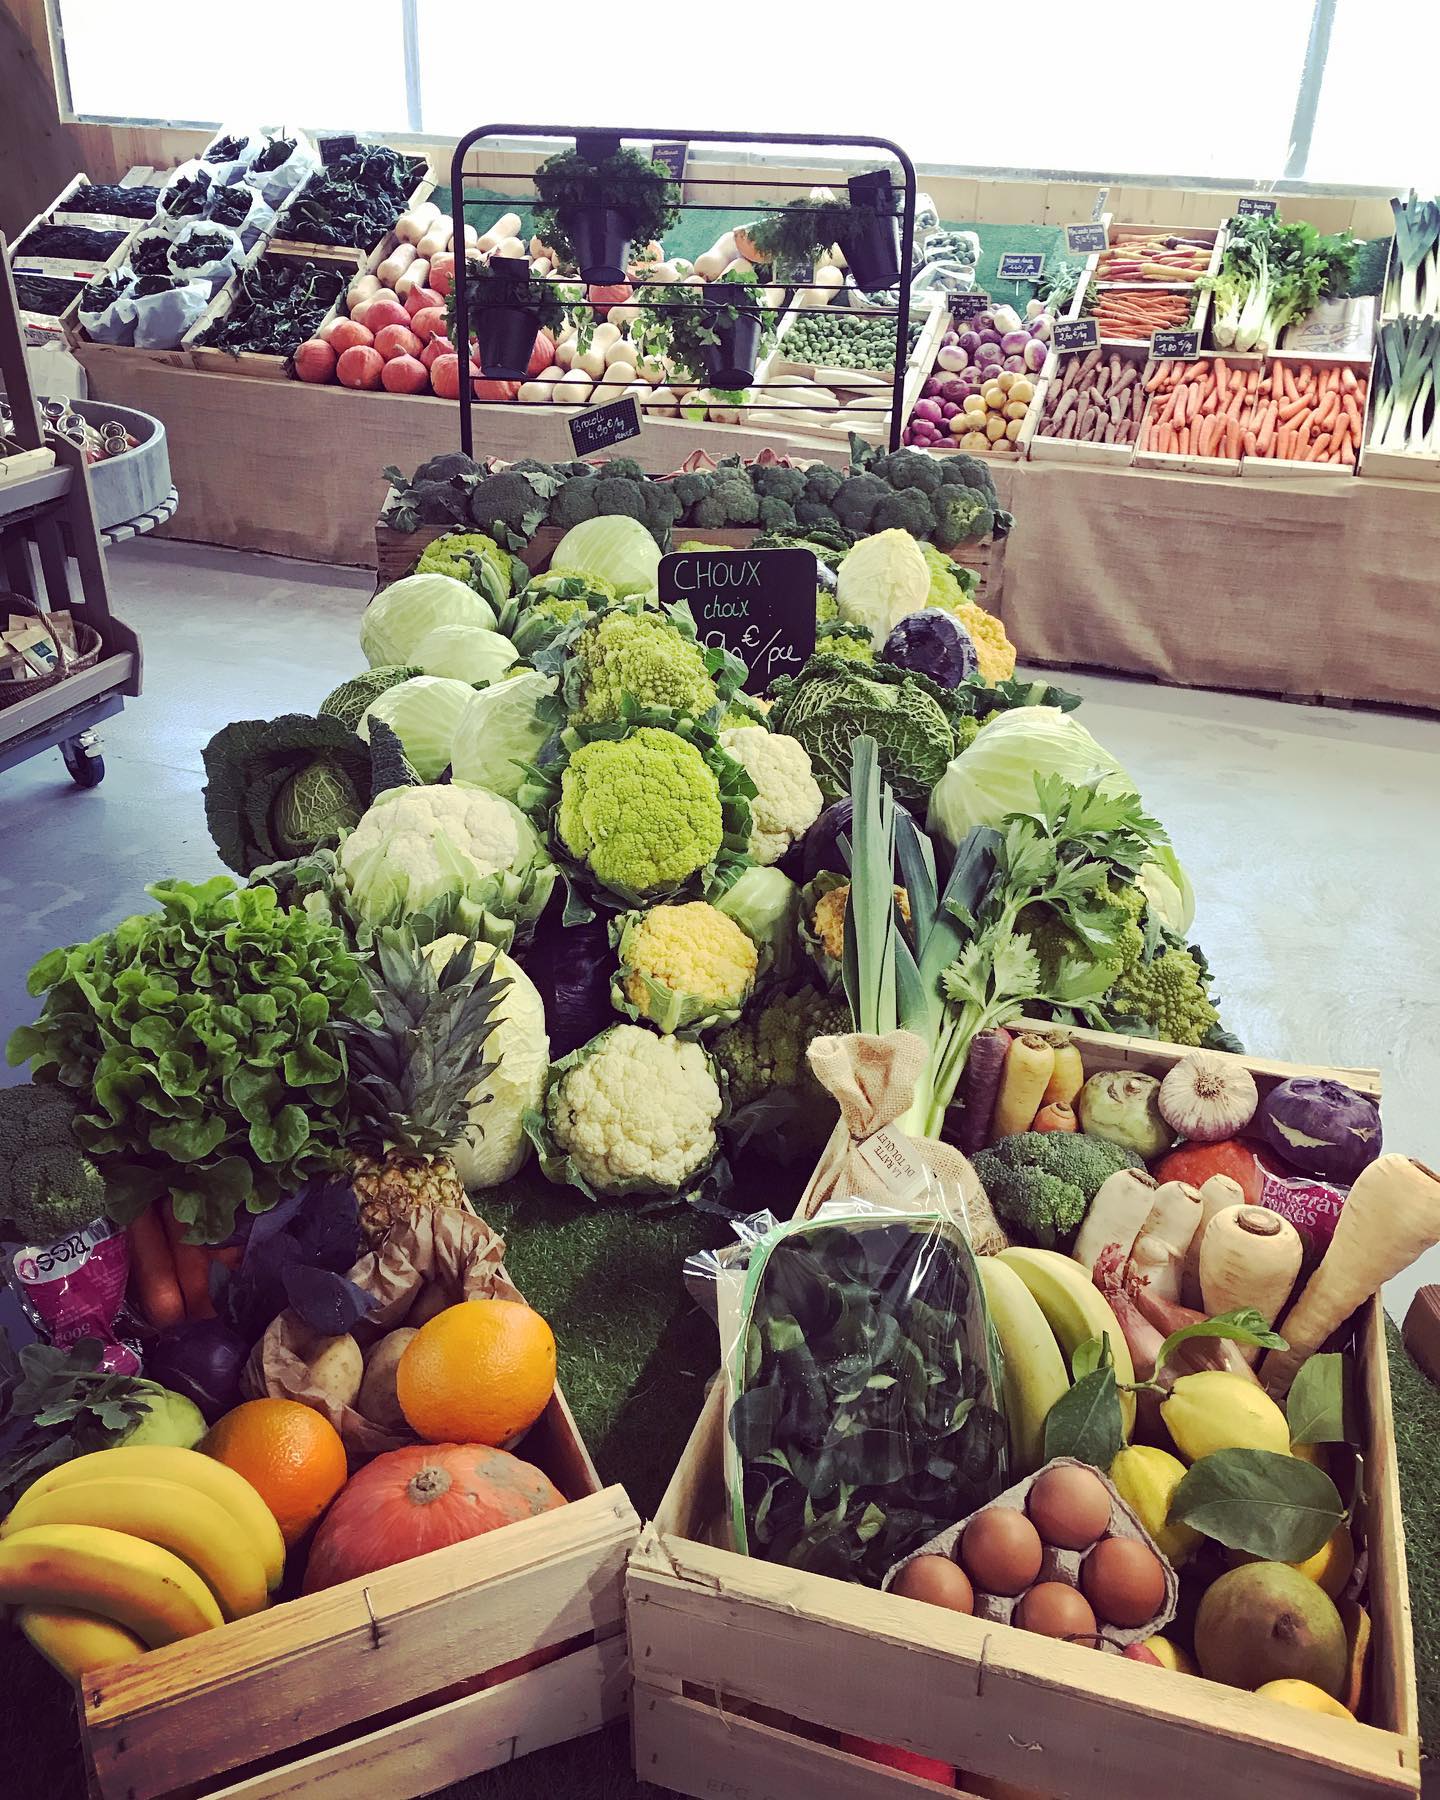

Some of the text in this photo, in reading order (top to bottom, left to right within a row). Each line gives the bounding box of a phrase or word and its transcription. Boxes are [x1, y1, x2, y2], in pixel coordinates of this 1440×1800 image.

[674, 560, 761, 590] CHOUX
[704, 595, 750, 619] choix
[873, 1145, 902, 1178] LA RATTE
[876, 1133, 916, 1177] DU TOUQUET
[1265, 1179, 1343, 1217] Betterav
